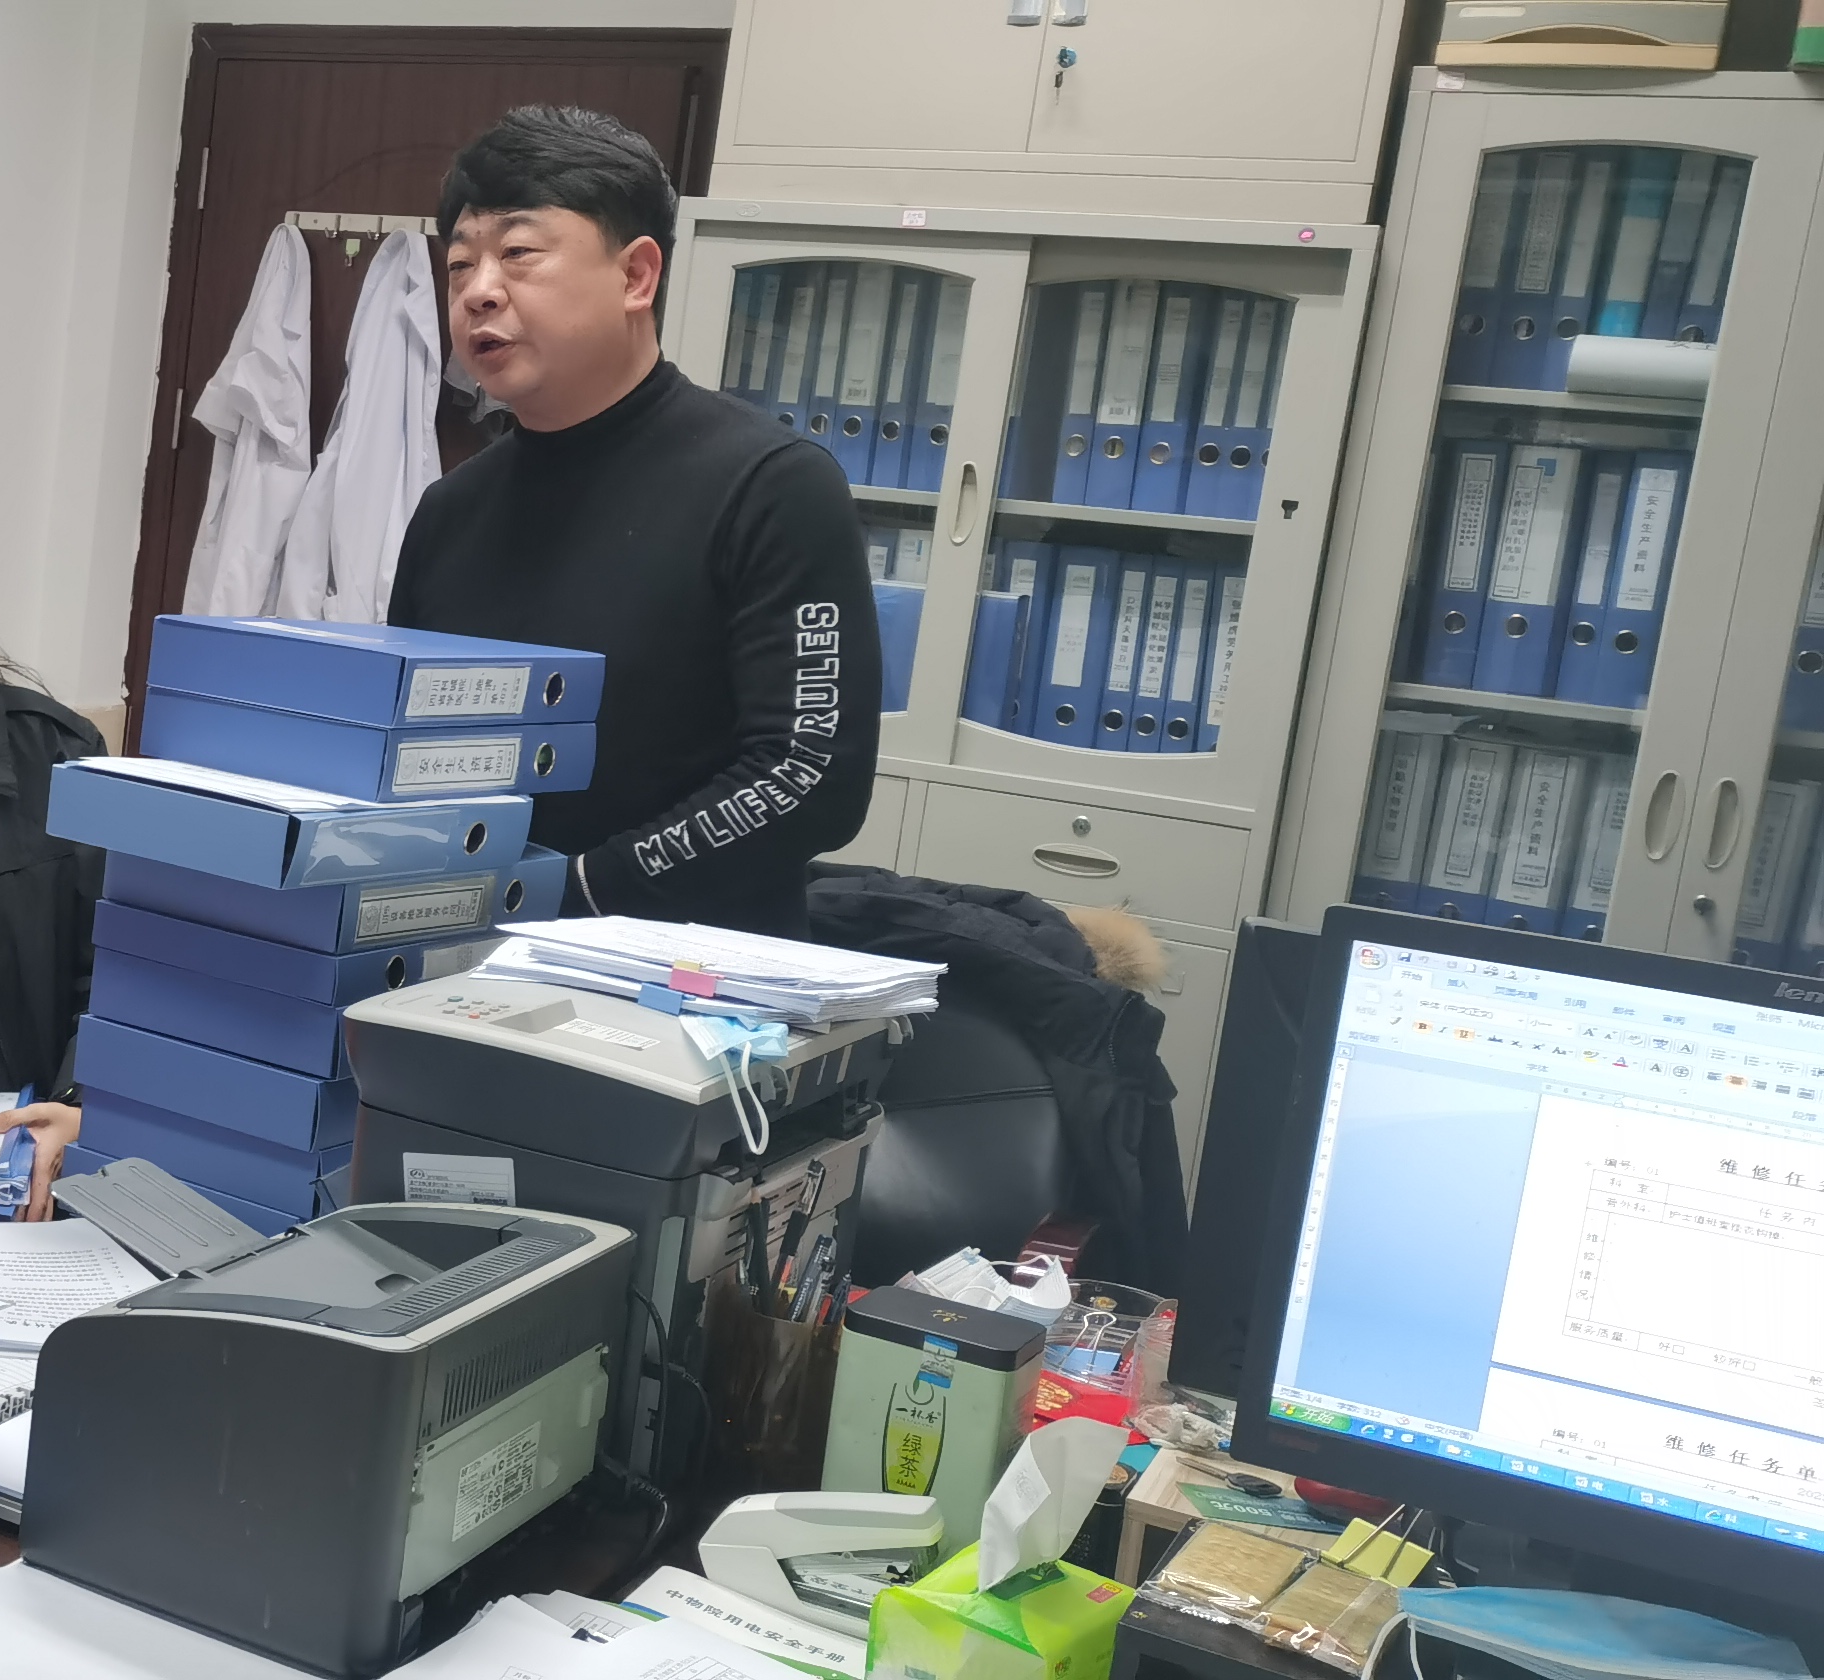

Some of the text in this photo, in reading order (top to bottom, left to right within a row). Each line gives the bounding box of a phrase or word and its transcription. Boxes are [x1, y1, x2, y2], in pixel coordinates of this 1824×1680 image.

[634, 820, 697, 877] MY
[695, 779, 800, 848] LIFE
[794, 602, 839, 738] RULES
[899, 1433, 922, 1479] 绿茶
[664, 1588, 846, 1664] 中物院用电安全手册
